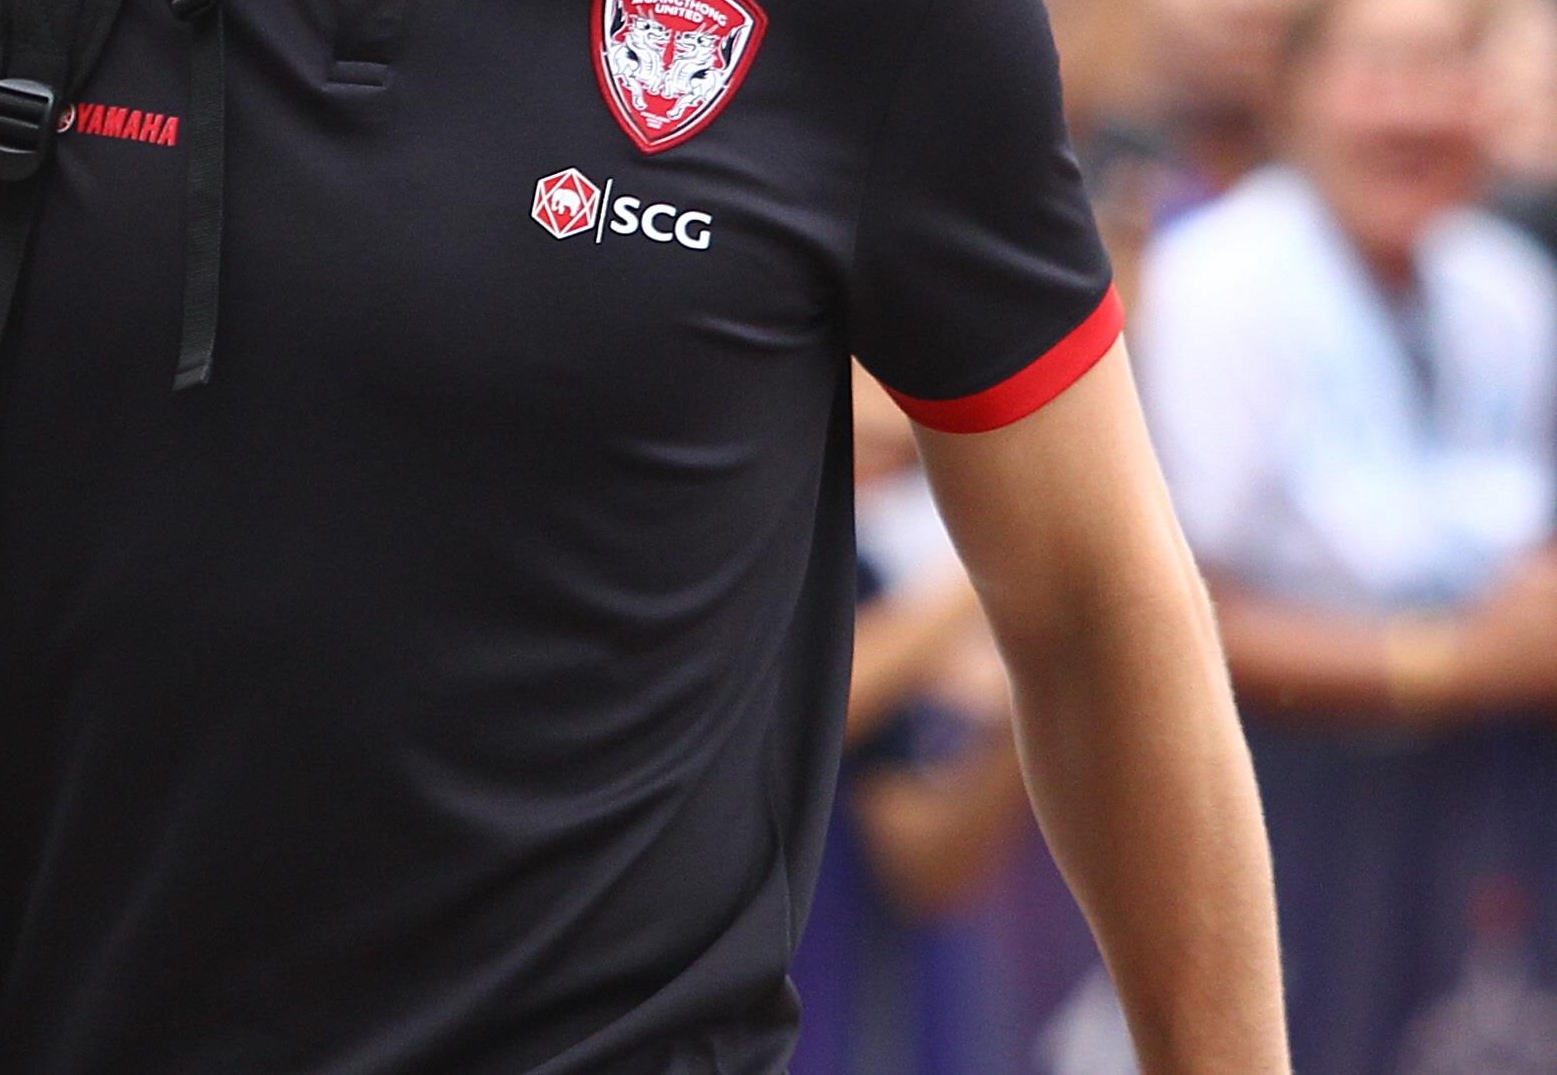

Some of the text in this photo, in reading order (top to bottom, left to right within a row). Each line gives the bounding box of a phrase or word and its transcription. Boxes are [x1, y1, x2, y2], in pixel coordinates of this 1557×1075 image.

[655, 4, 703, 23] UNITED
[76, 102, 180, 146] YAMAHA
[610, 196, 712, 250] SCG
